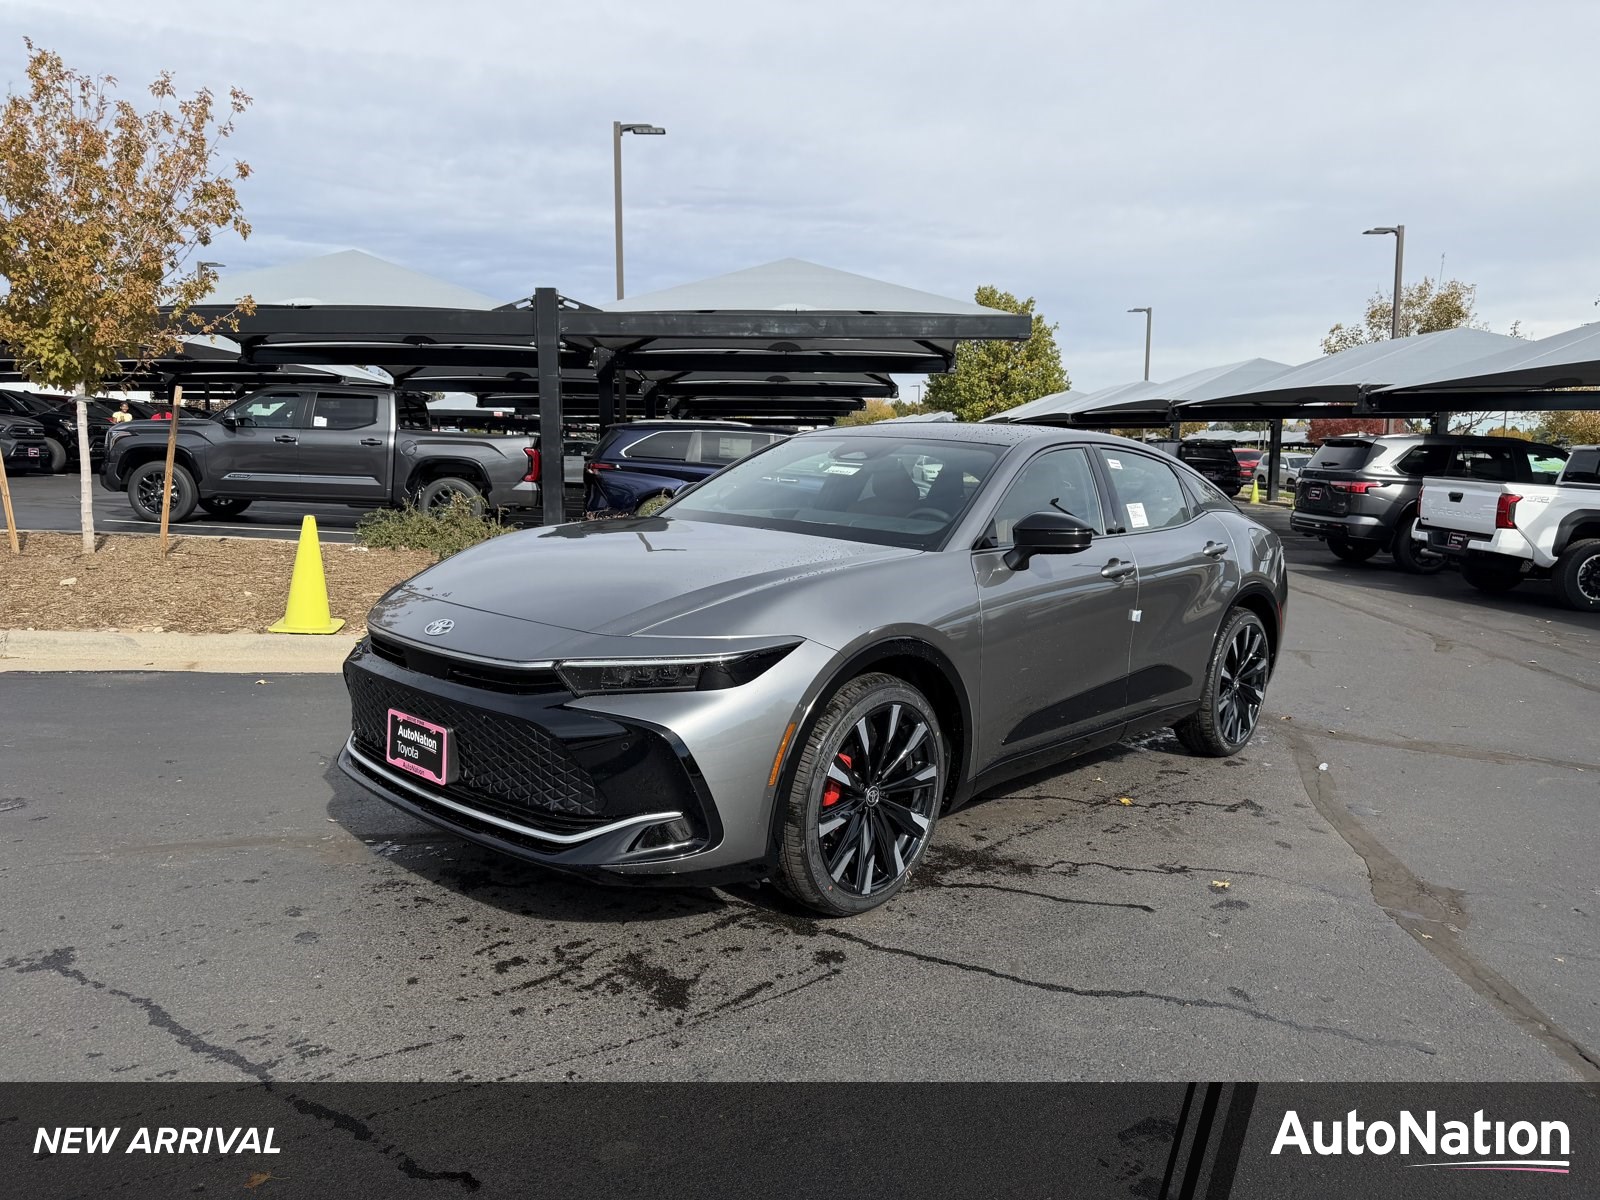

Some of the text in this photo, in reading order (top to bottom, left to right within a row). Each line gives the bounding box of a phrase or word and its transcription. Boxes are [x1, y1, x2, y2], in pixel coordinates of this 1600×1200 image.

[1431, 507, 1481, 519] TACOMA
[398, 725, 437, 749] AutoNation
[397, 741, 419, 759] Toyota
[402, 762, 425, 776] AutoNation
